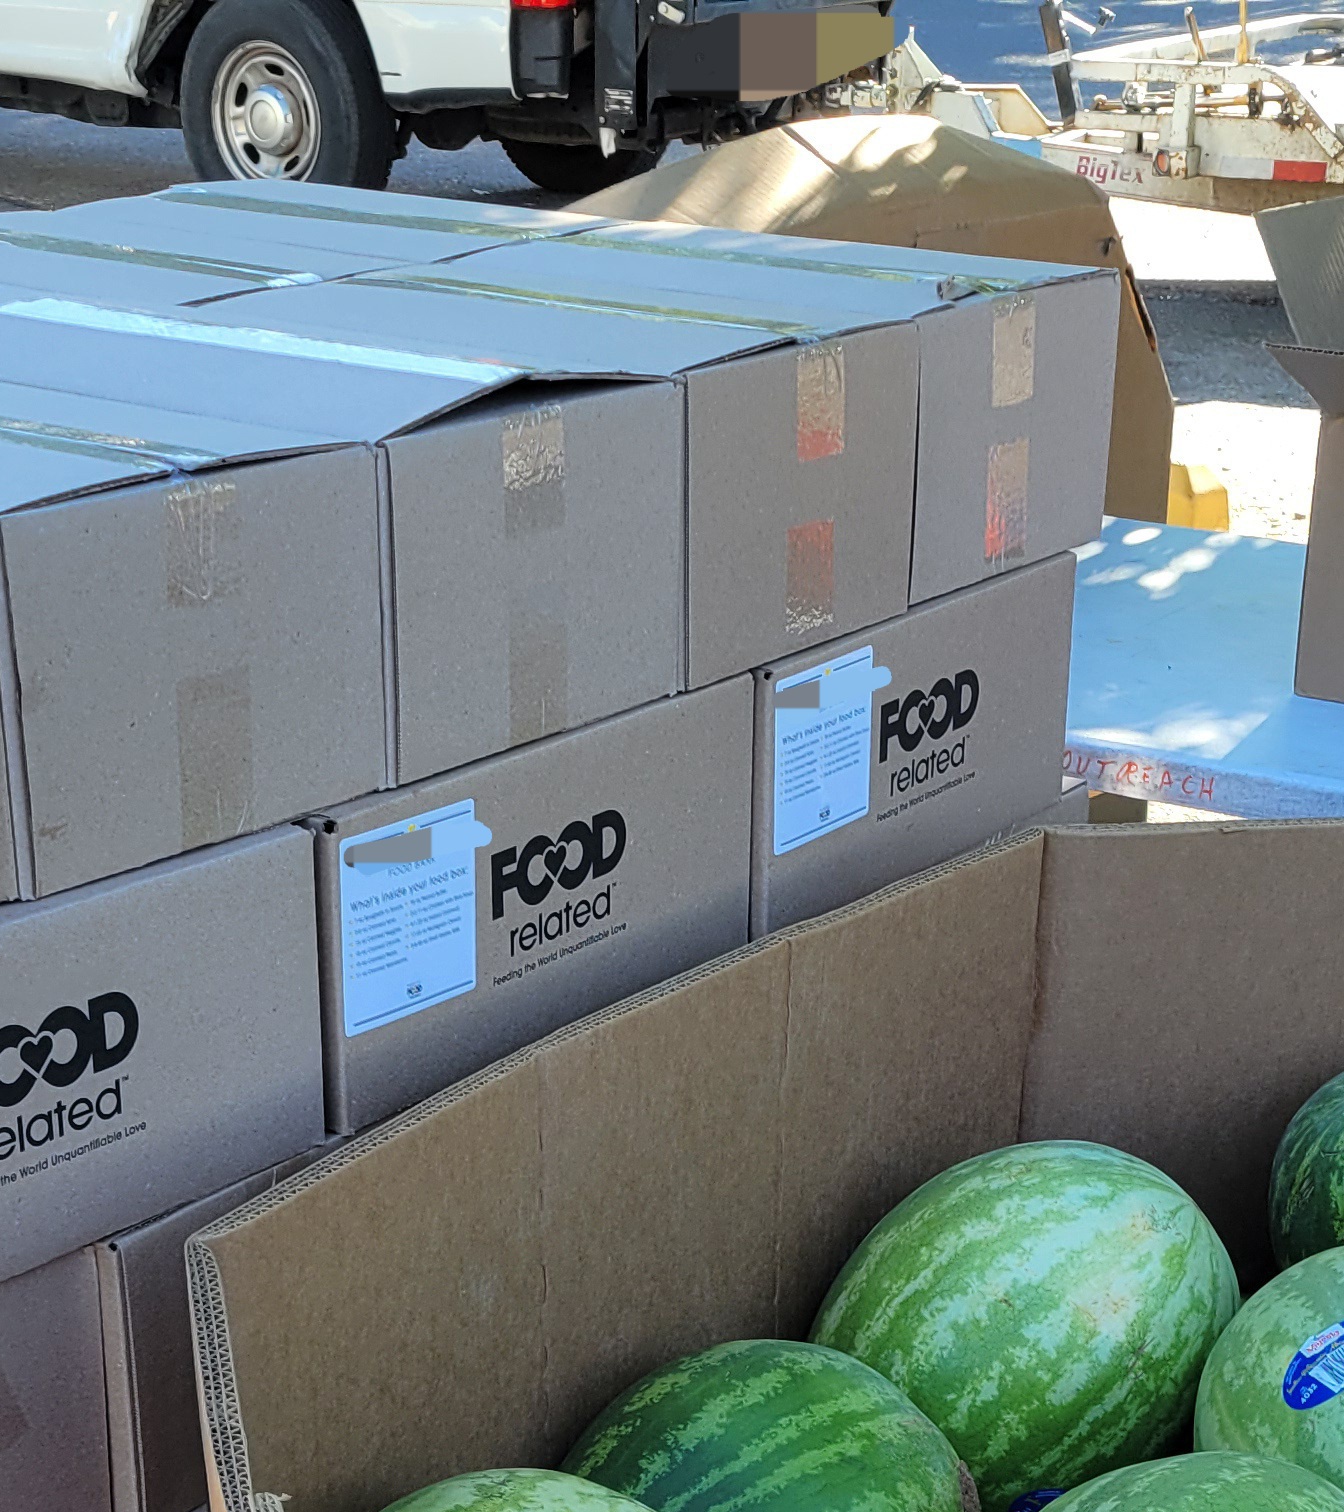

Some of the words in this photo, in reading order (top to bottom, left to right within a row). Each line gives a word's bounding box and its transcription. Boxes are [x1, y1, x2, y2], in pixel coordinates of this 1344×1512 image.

[879, 669, 979, 764] FOOD
[890, 736, 965, 796] related
[1062, 751, 1215, 800] OUTREACH
[491, 809, 626, 921] FOOD
[510, 884, 611, 957] related
[1, 1173, 17, 1184] the
[19, 1159, 48, 1177] World
[51, 1132, 122, 1166] Unquantifiable
[124, 1122, 147, 1137] Love
